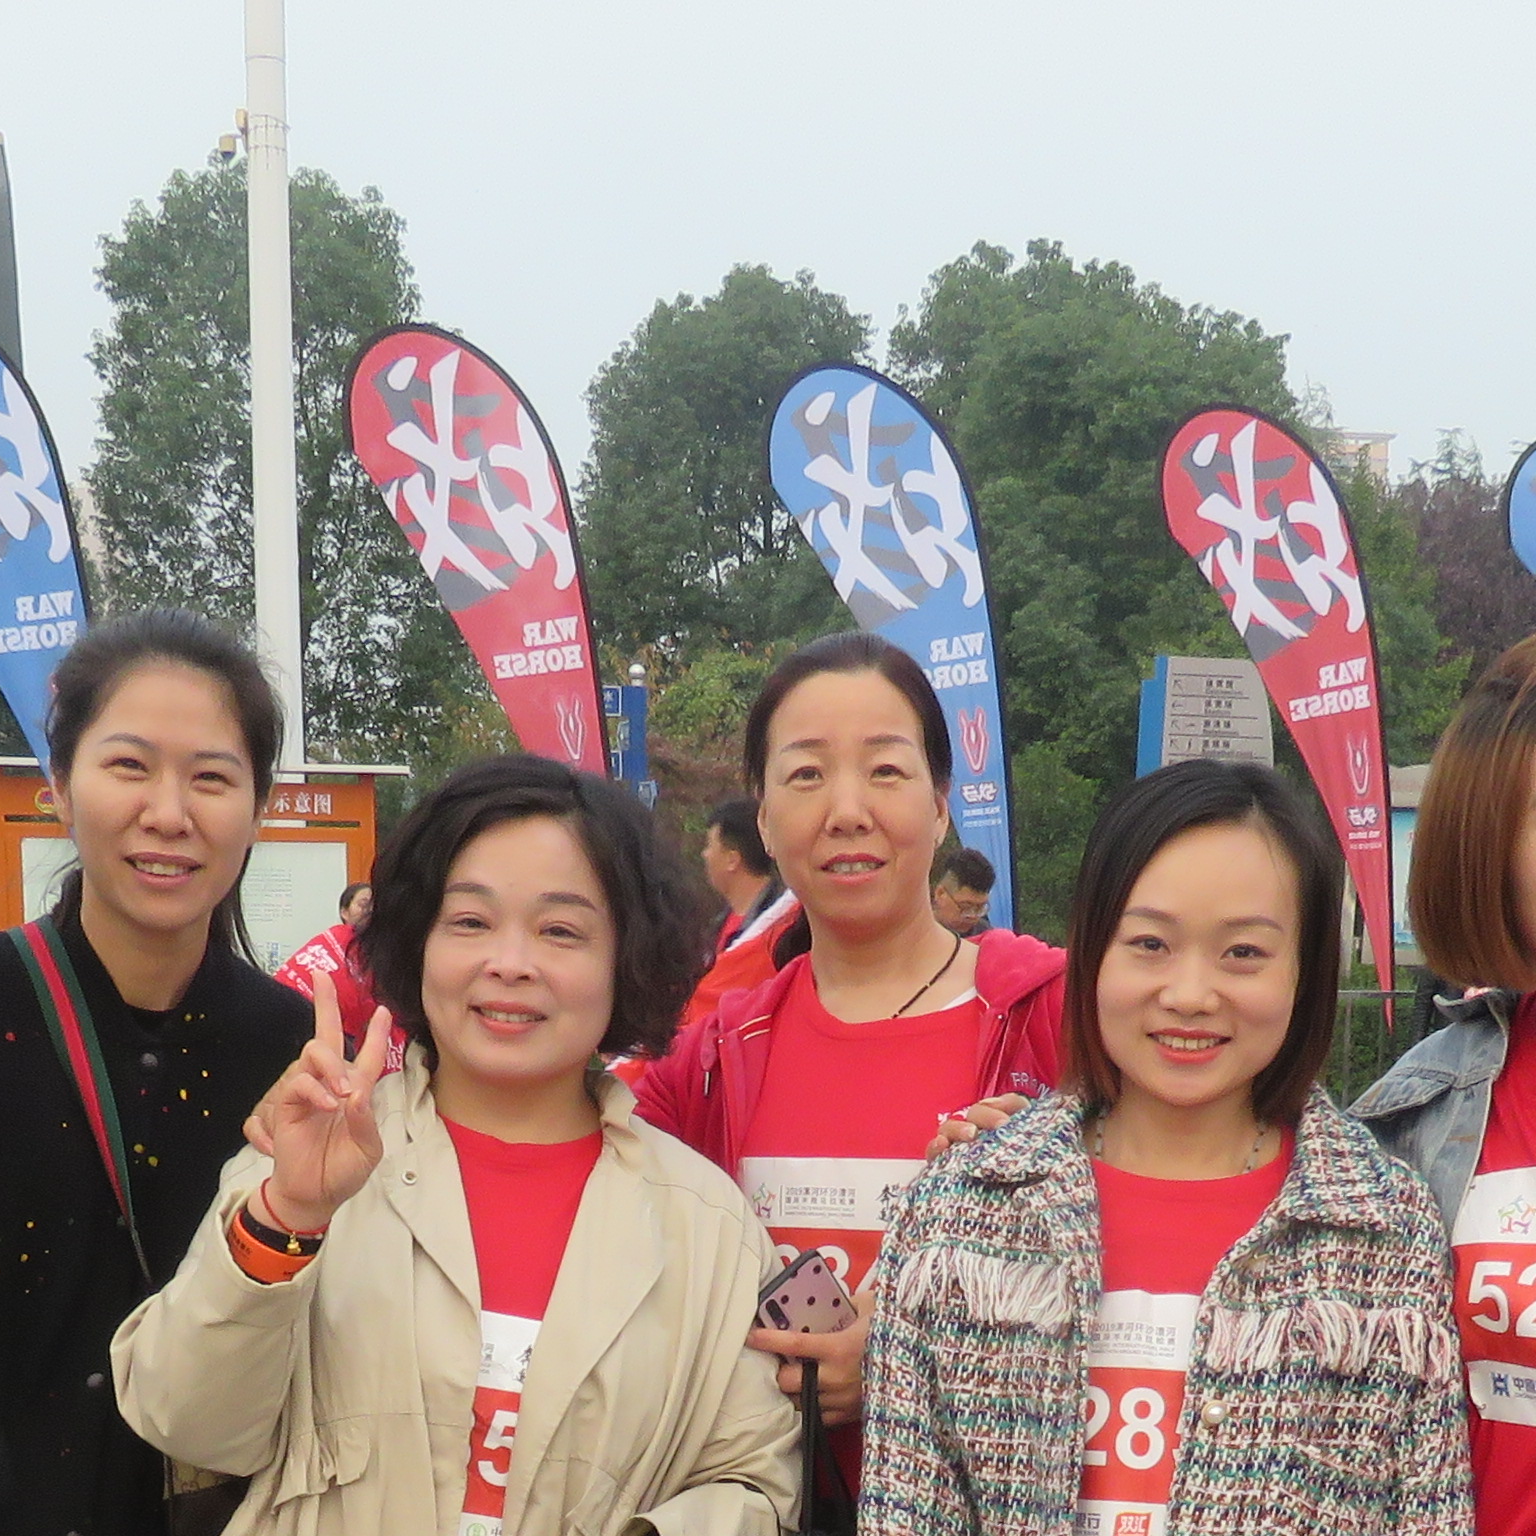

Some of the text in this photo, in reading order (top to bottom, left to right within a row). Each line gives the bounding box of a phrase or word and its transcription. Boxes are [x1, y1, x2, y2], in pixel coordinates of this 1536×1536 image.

[263, 791, 332, 815] 示意图
[1083, 1386, 1182, 1471] 28
